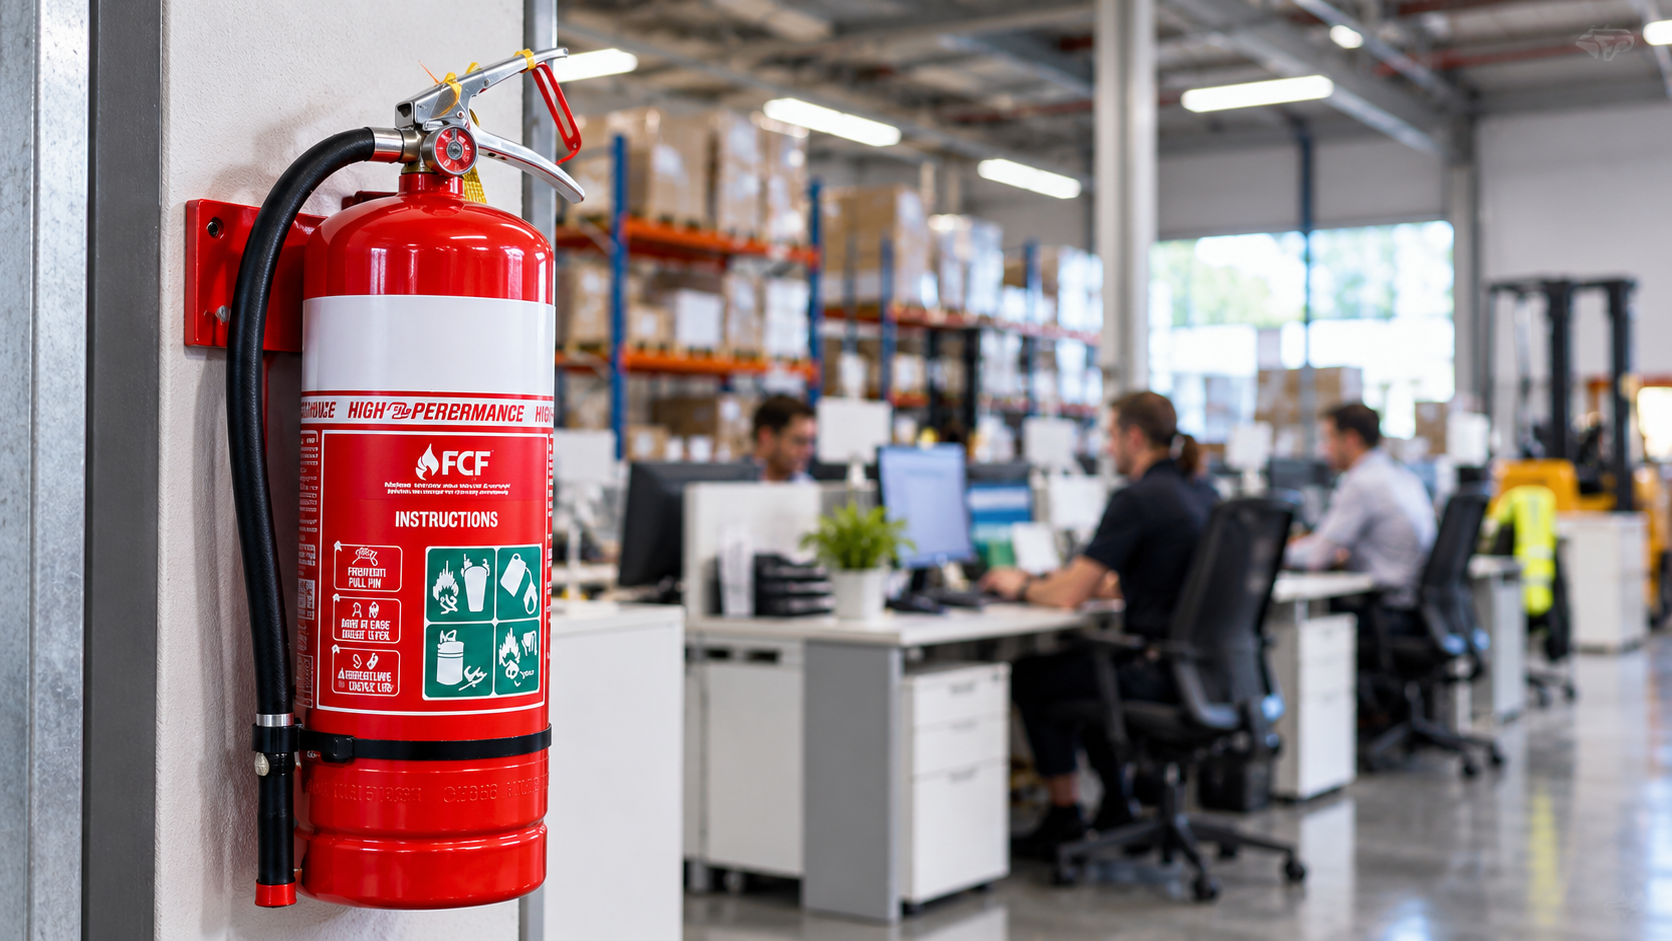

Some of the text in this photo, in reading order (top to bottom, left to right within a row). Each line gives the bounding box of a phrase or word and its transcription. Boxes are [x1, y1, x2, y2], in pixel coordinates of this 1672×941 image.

[348, 401, 387, 419] HIGH
[442, 450, 491, 476] FCF
[395, 511, 498, 528] INSTRUCTIONS
